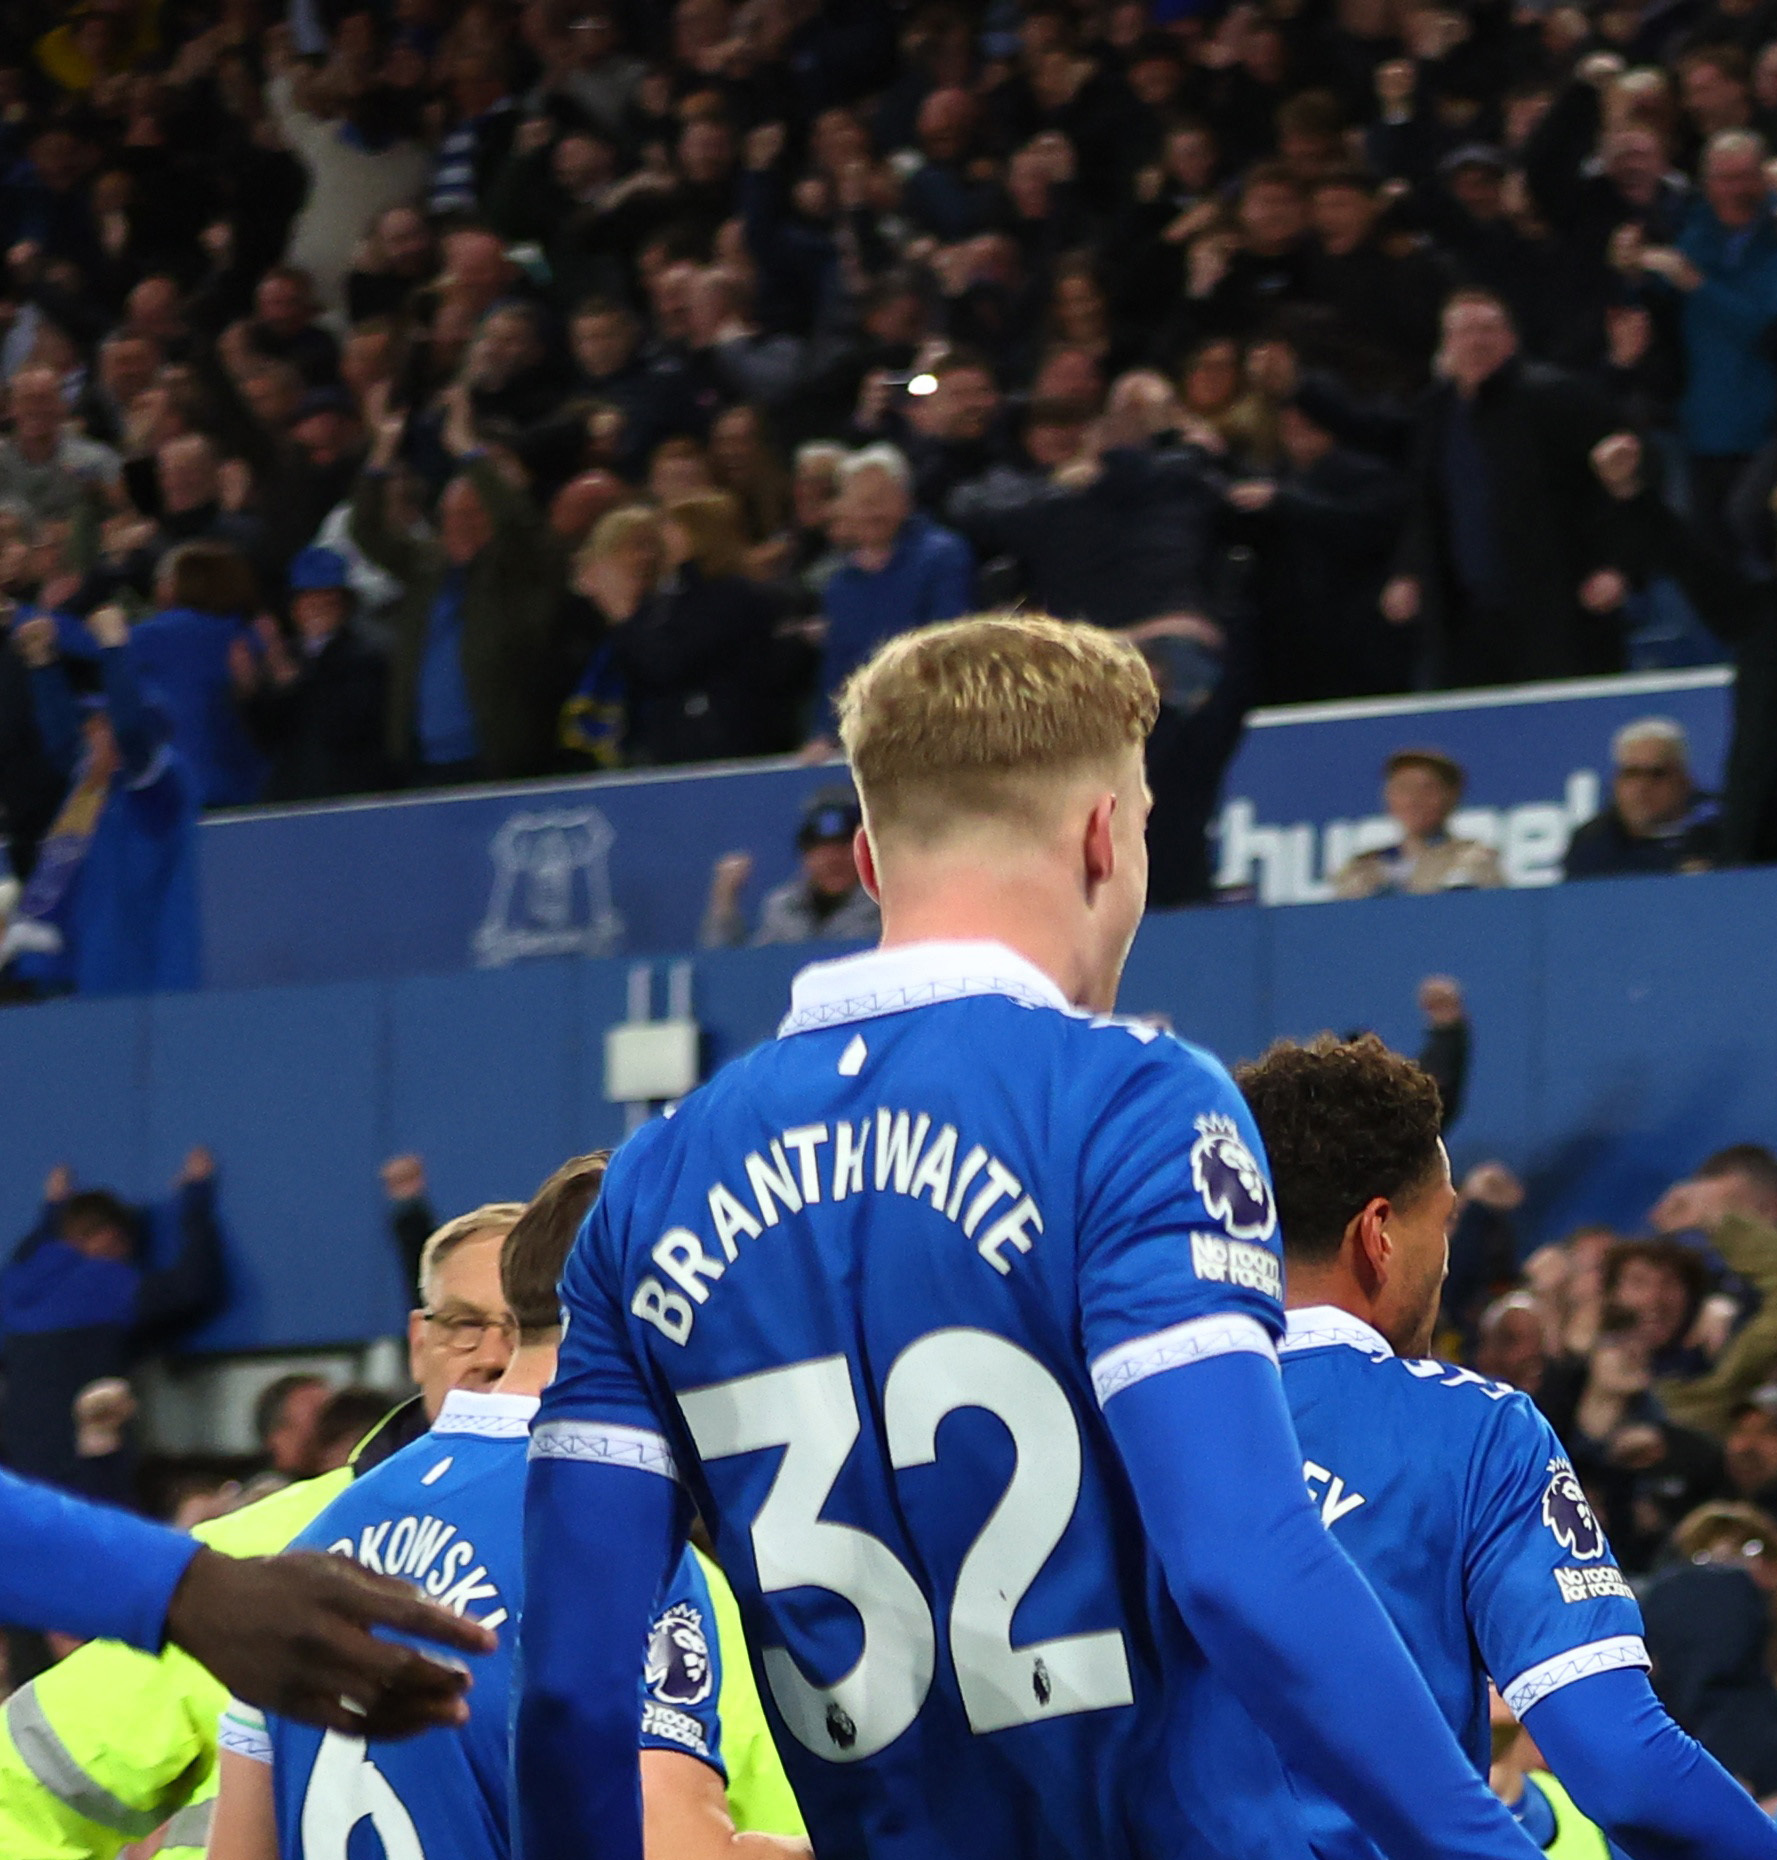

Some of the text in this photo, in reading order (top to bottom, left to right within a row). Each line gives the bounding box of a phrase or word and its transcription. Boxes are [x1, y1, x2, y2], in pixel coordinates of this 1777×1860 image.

[631, 1107, 1045, 1346] BRANTHWAITE
[1189, 1230, 1228, 1265] No
[326, 1514, 509, 1632] KOWSKI
[676, 1326, 1133, 1762] 32
[1553, 1567, 1584, 1585] No
